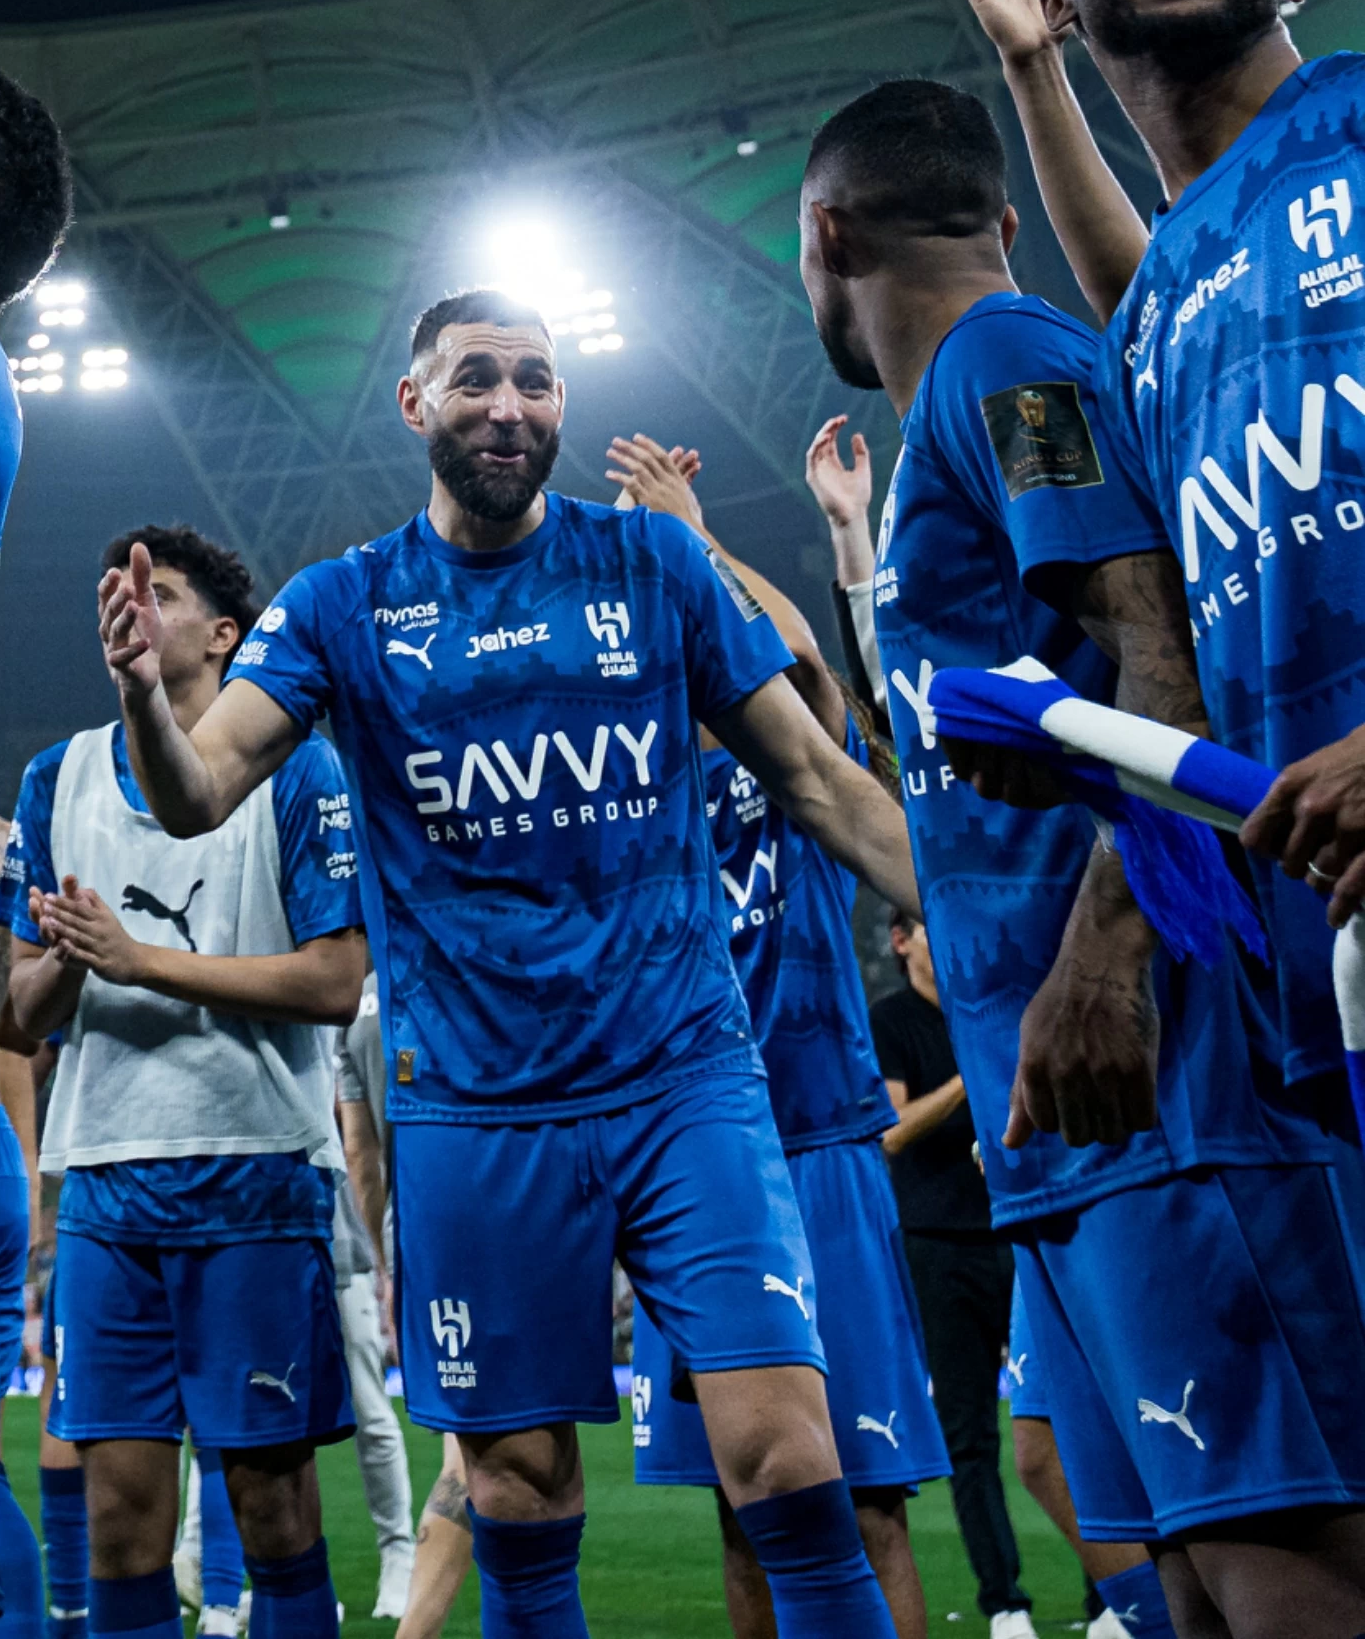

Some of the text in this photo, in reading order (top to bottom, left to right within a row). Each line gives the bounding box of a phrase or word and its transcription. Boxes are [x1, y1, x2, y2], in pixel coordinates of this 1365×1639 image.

[1299, 254, 1364, 290] ALHILAL
[404, 719, 659, 815] SAVVY
[426, 796, 658, 842] GAMES GROUP
